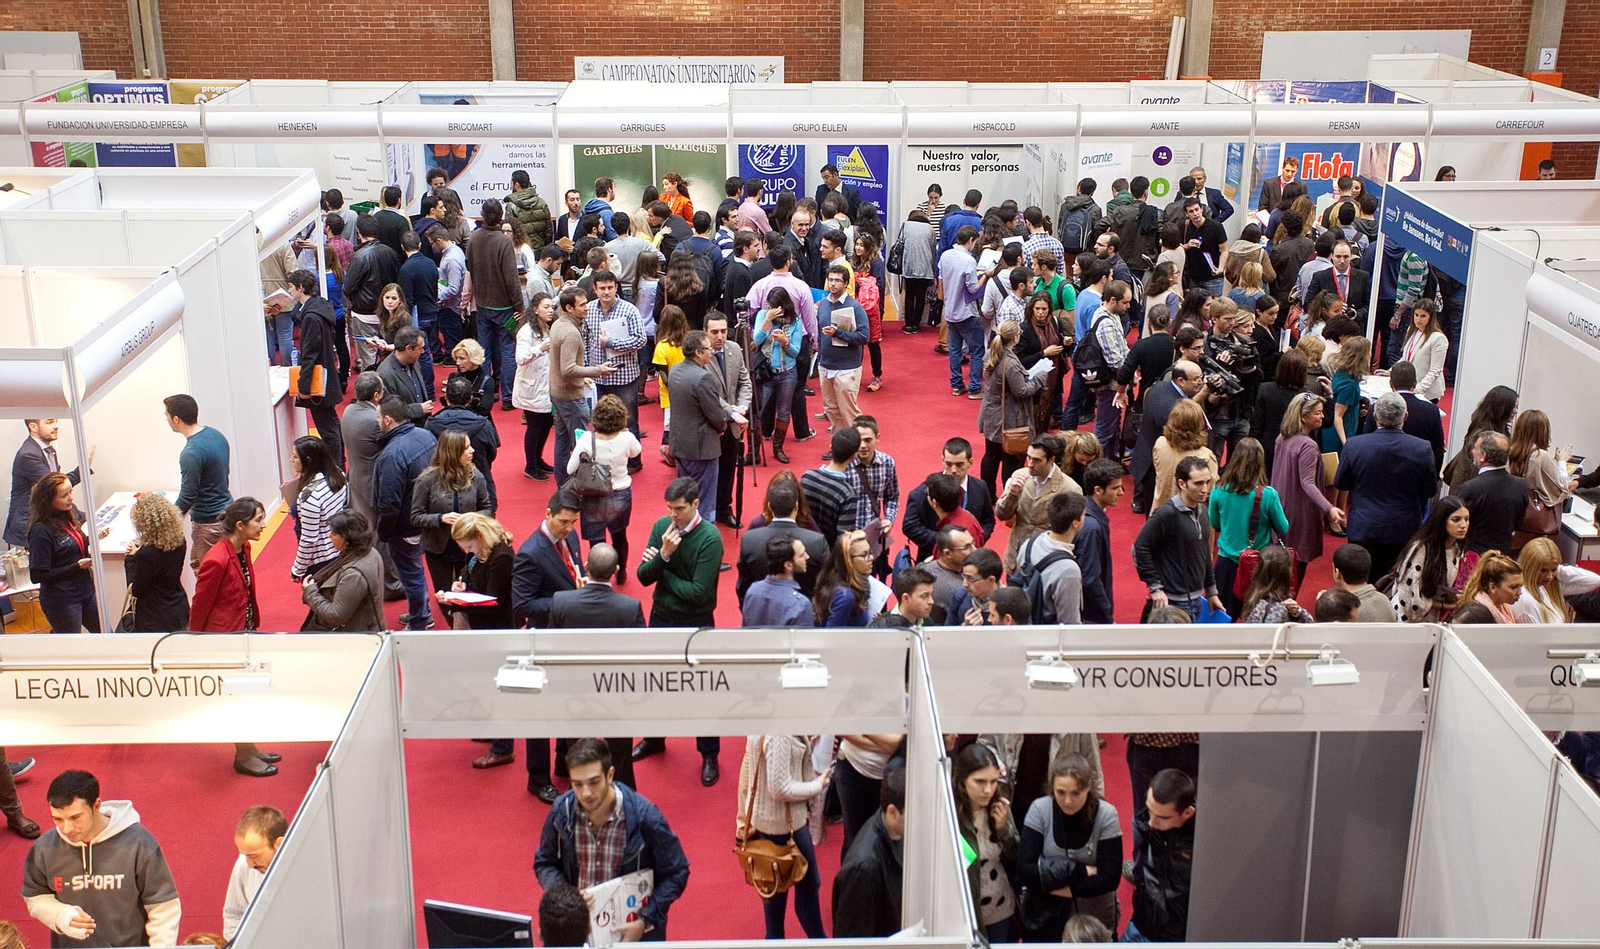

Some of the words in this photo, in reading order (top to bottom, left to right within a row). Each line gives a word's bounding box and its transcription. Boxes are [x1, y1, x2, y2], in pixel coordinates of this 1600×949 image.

[1543, 52, 1551, 65] 2
[602, 64, 676, 83] CAMPEONATOS
[677, 64, 756, 83] UNIVERSITARIOS
[124, 85, 164, 93] programa
[92, 93, 165, 104] OPTIMUS
[47, 120, 94, 130] FUNDACION
[95, 120, 189, 130] UNIVERSIDAD-EMPRESA
[277, 122, 318, 131] HEINEKEN
[448, 122, 493, 131] BRICOMART
[620, 123, 666, 132] GARRIGUES
[792, 123, 820, 132] GRUPO
[822, 123, 848, 132] EULEN
[972, 122, 1016, 131] HISPACOLD
[1150, 121, 1180, 130] AVANTE
[1328, 121, 1361, 130] PERSAN
[1495, 120, 1545, 129] CARREFOUR
[583, 144, 643, 156] GARRIGUES
[663, 144, 718, 154] GARRIGUES
[922, 149, 964, 161] Nuestro
[970, 149, 1001, 162] valor,
[1081, 152, 1114, 166] avante
[491, 161, 547, 169] herramientas.
[917, 162, 961, 172] nuestras
[971, 163, 1020, 175] personas
[1301, 153, 1353, 180] Flota
[470, 182, 478, 191] el
[482, 182, 512, 191] FUTU
[761, 177, 796, 191] RUPO
[862, 181, 883, 189] empleo
[120, 335, 139, 360] AIRBUS
[138, 320, 155, 344] GROUP
[593, 672, 635, 693] WIN
[644, 670, 730, 692] INERTIA
[1074, 667, 1107, 688] YR
[1113, 665, 1278, 688] CONSULTORES
[14, 677, 89, 699] LEGAL
[54, 874, 125, 892] E-SPORT
